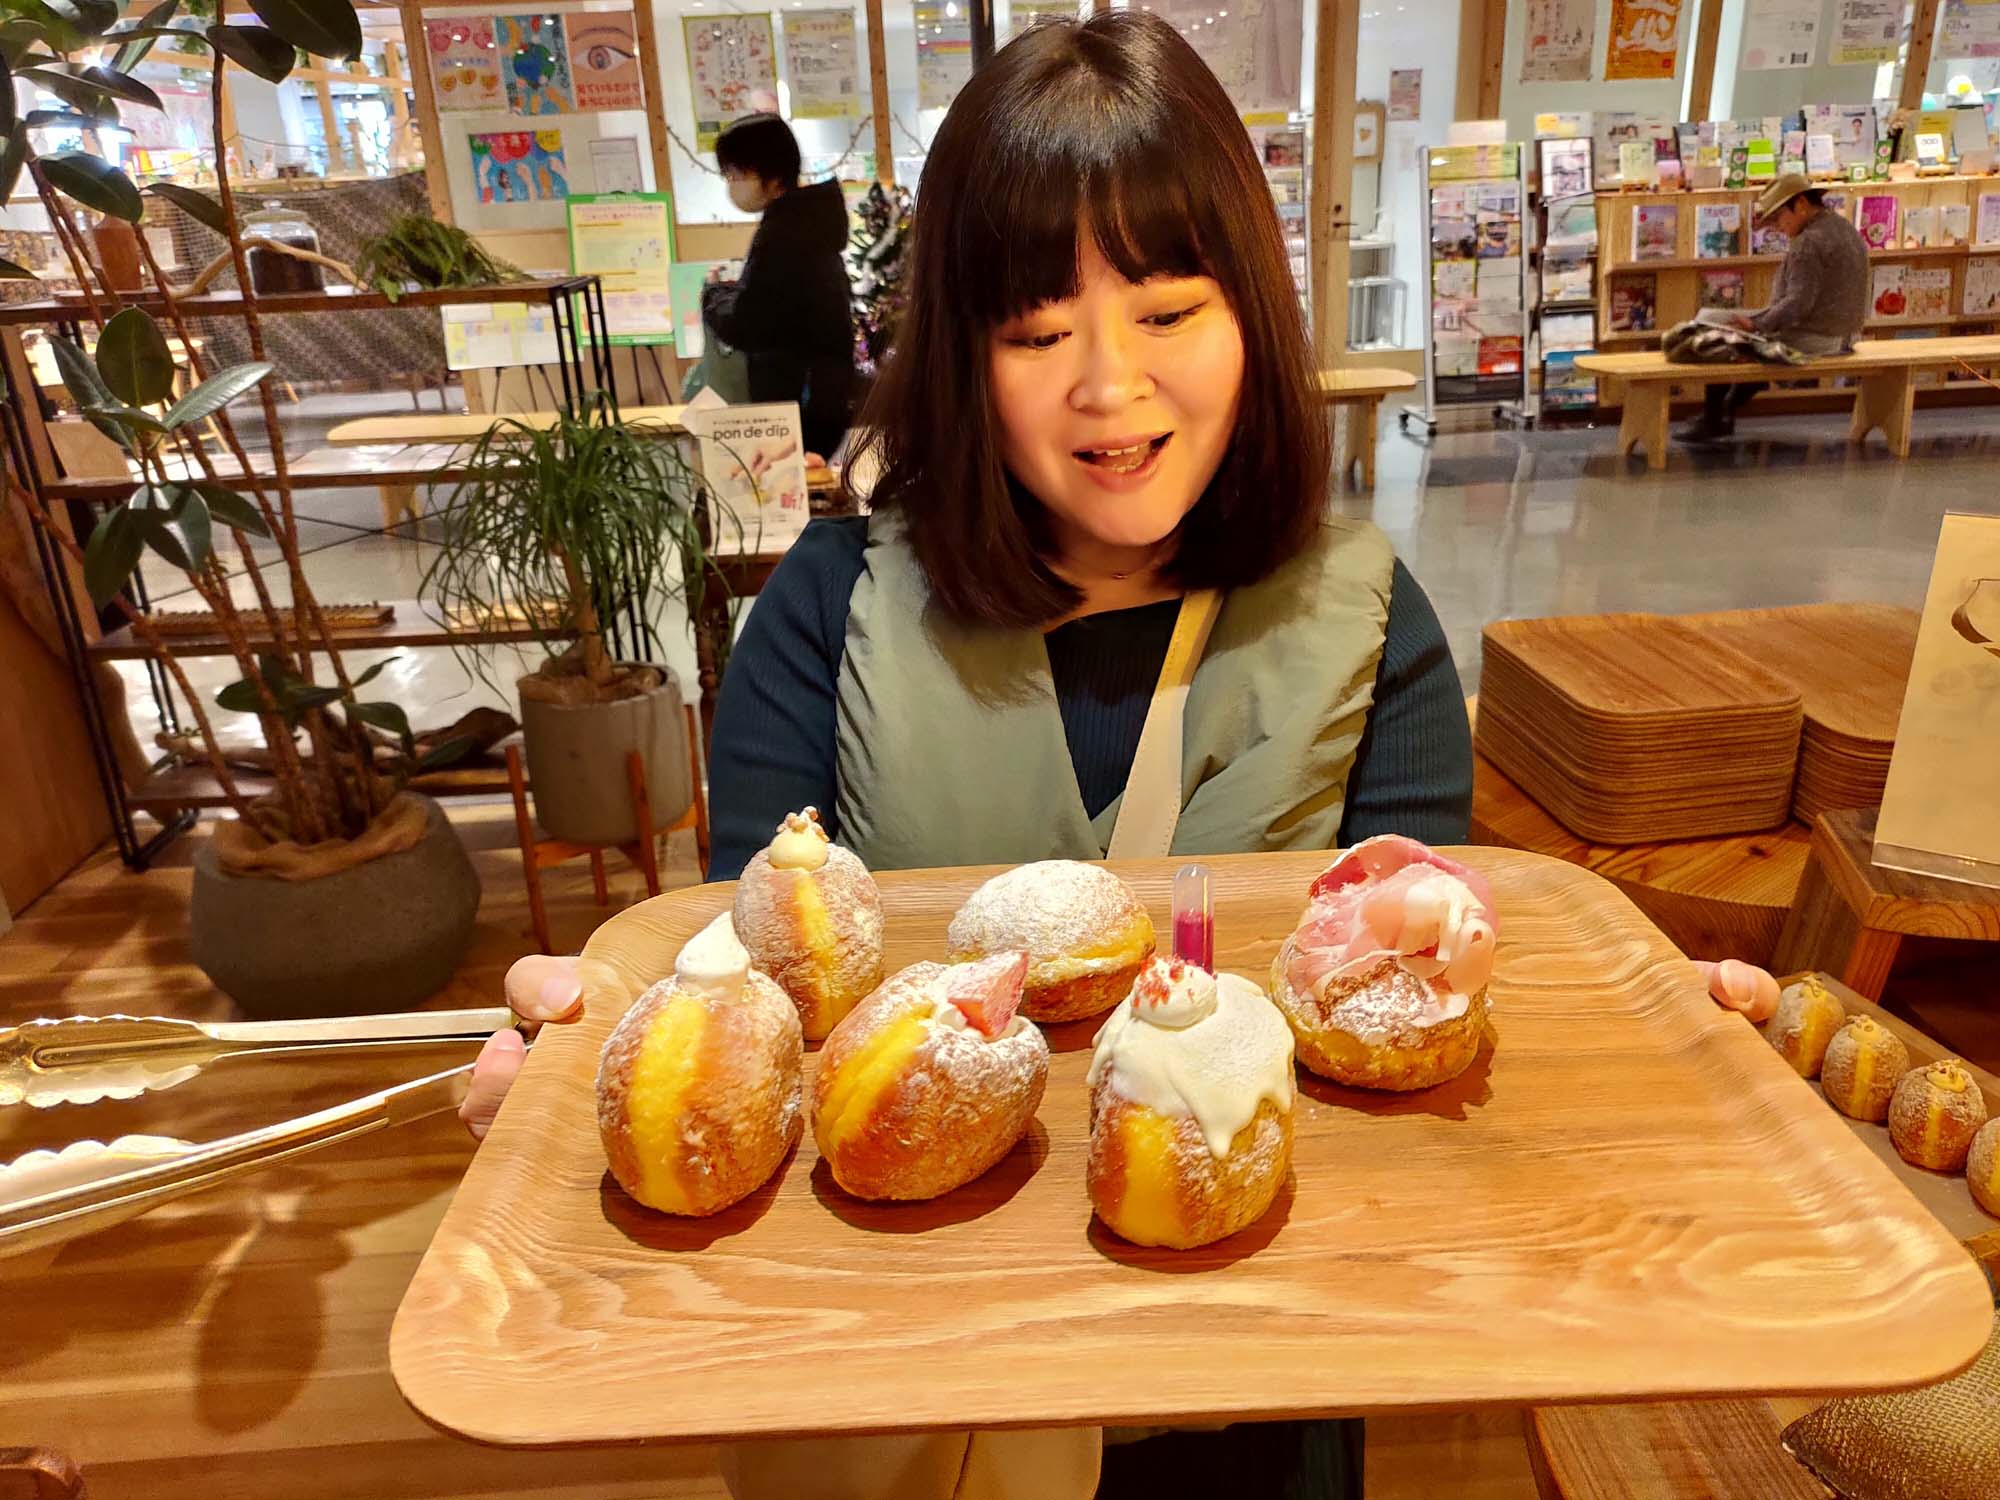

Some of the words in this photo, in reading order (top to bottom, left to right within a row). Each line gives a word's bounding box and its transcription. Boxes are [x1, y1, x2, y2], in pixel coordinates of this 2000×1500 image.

[713, 429, 741, 442] pon
[743, 426, 763, 438] de
[765, 425, 790, 438] dip
